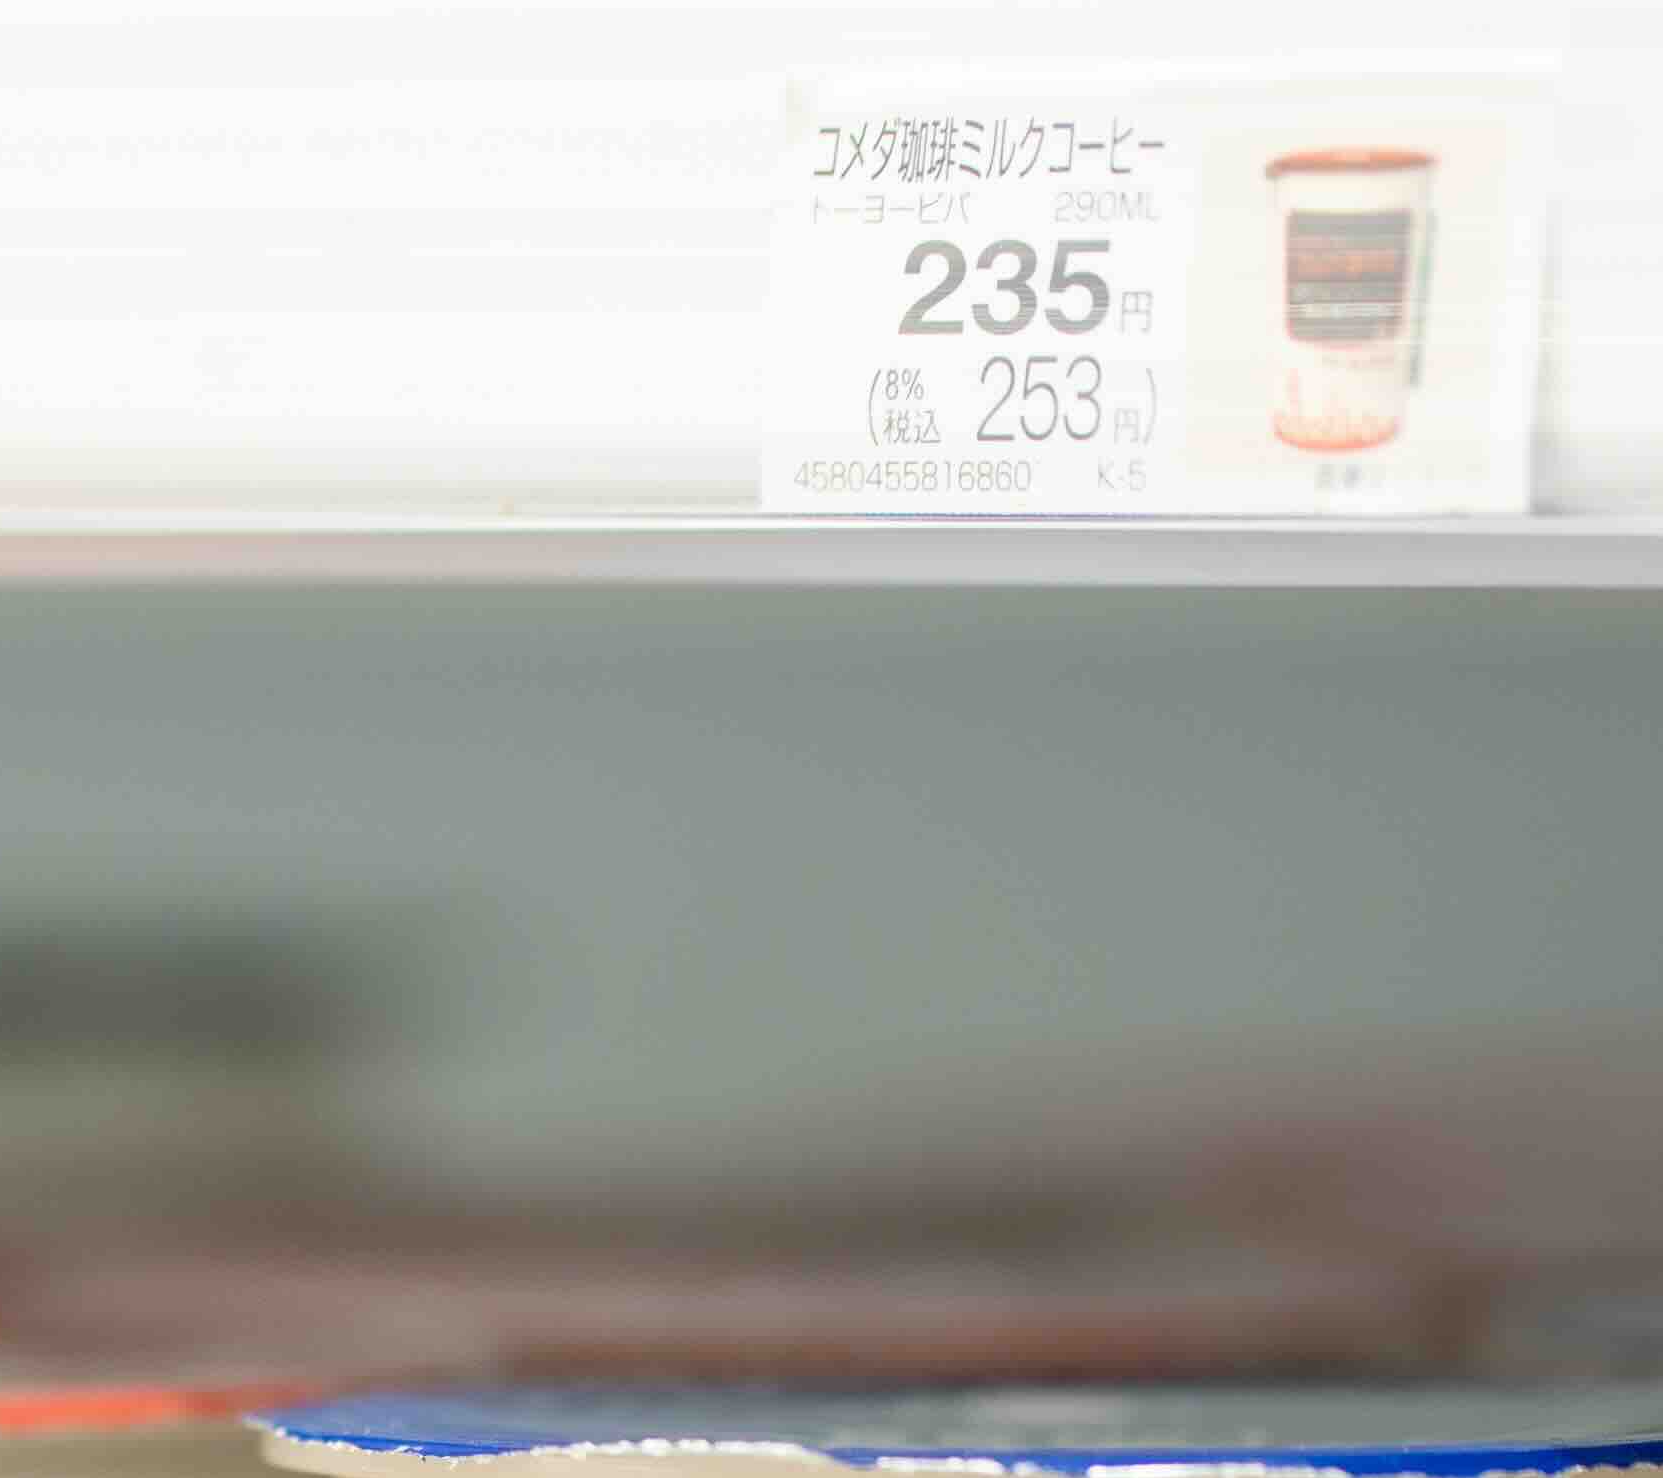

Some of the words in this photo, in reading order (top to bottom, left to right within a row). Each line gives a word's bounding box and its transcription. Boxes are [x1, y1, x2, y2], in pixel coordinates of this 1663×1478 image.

[813, 116, 1165, 182] コメダ珈琲ミルクコーヒー
[794, 460, 1032, 492] 4580455816860
